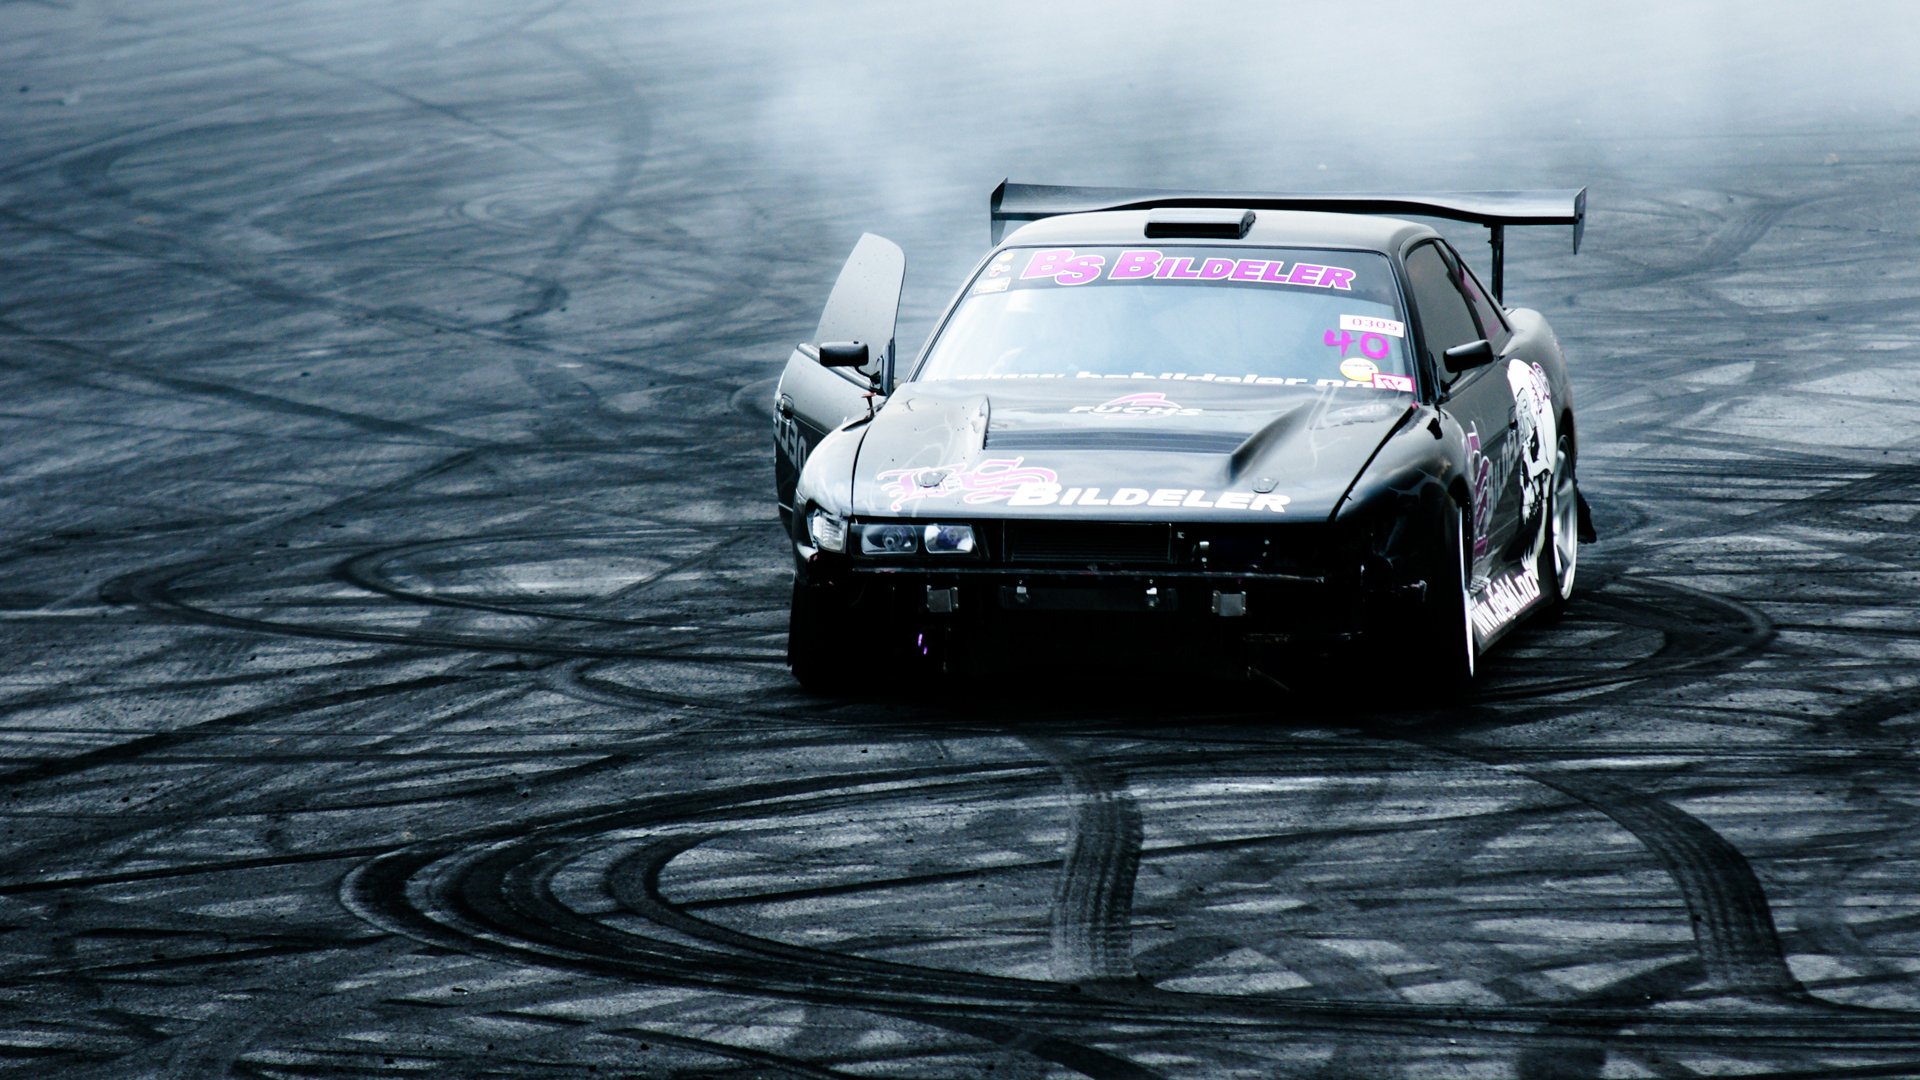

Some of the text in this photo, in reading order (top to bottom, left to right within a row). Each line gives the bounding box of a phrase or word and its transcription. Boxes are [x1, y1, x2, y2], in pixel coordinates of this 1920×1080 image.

[1021, 250, 1355, 290] BS BILDELER
[1352, 318, 1397, 331] 0305
[1323, 328, 1390, 360] 40
[1069, 405, 1203, 416] FUCHS
[1007, 482, 1291, 514] BILDELER
